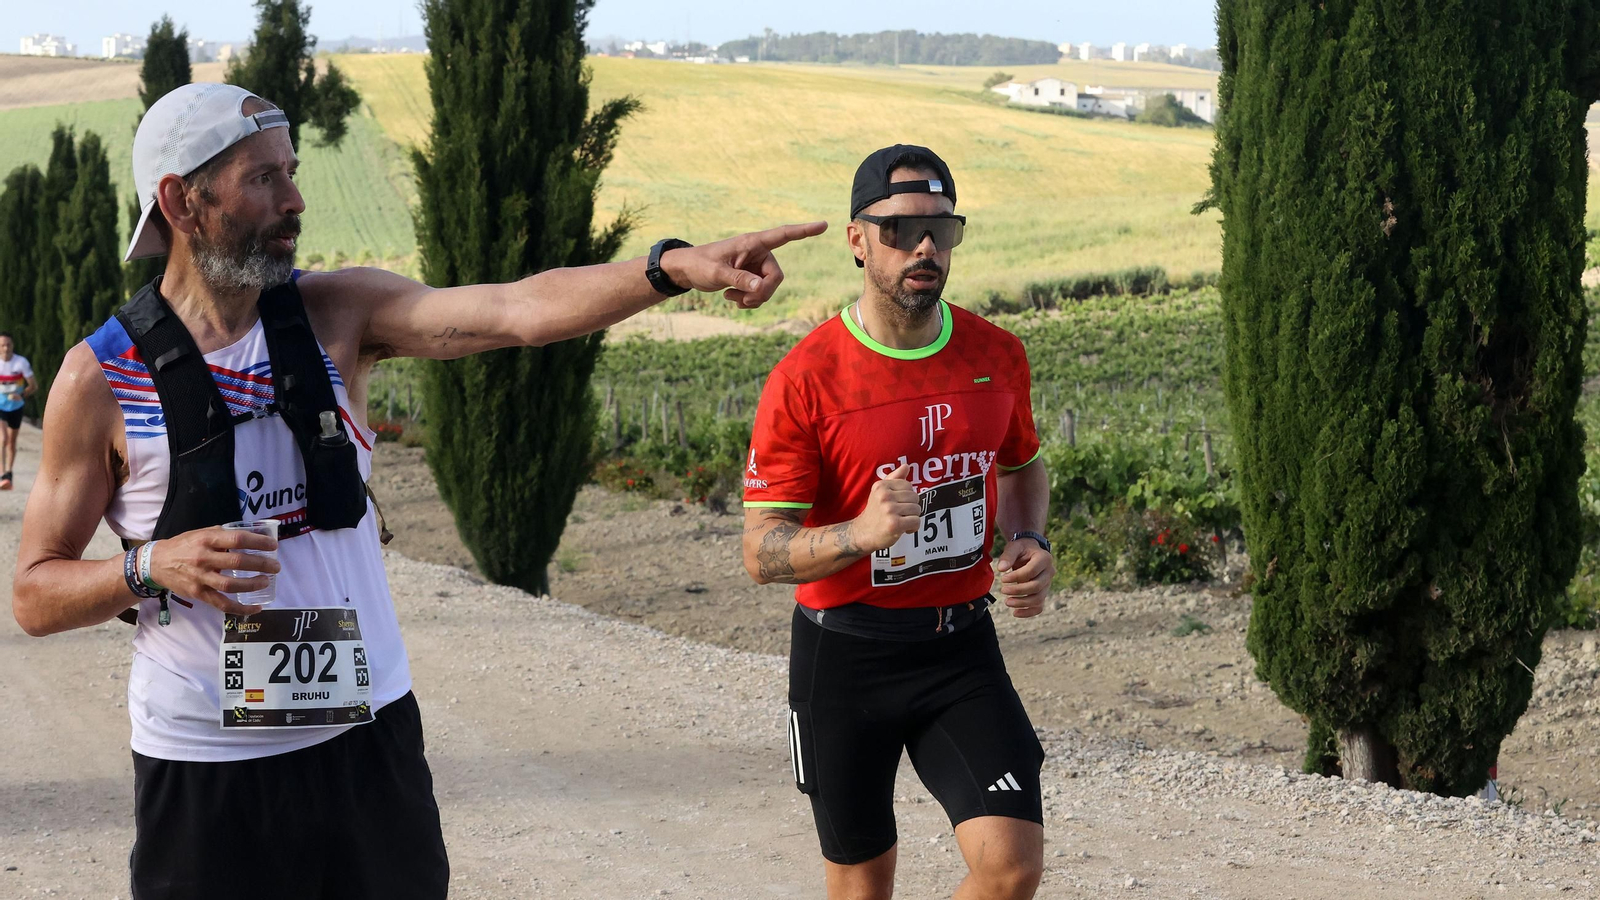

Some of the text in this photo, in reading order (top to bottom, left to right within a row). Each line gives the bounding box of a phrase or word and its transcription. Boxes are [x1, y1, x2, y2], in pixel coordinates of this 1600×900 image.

[925, 545, 949, 556] MAWI
[237, 622, 262, 632] herry
[268, 642, 338, 684] 202
[292, 691, 330, 701] BRUHU
